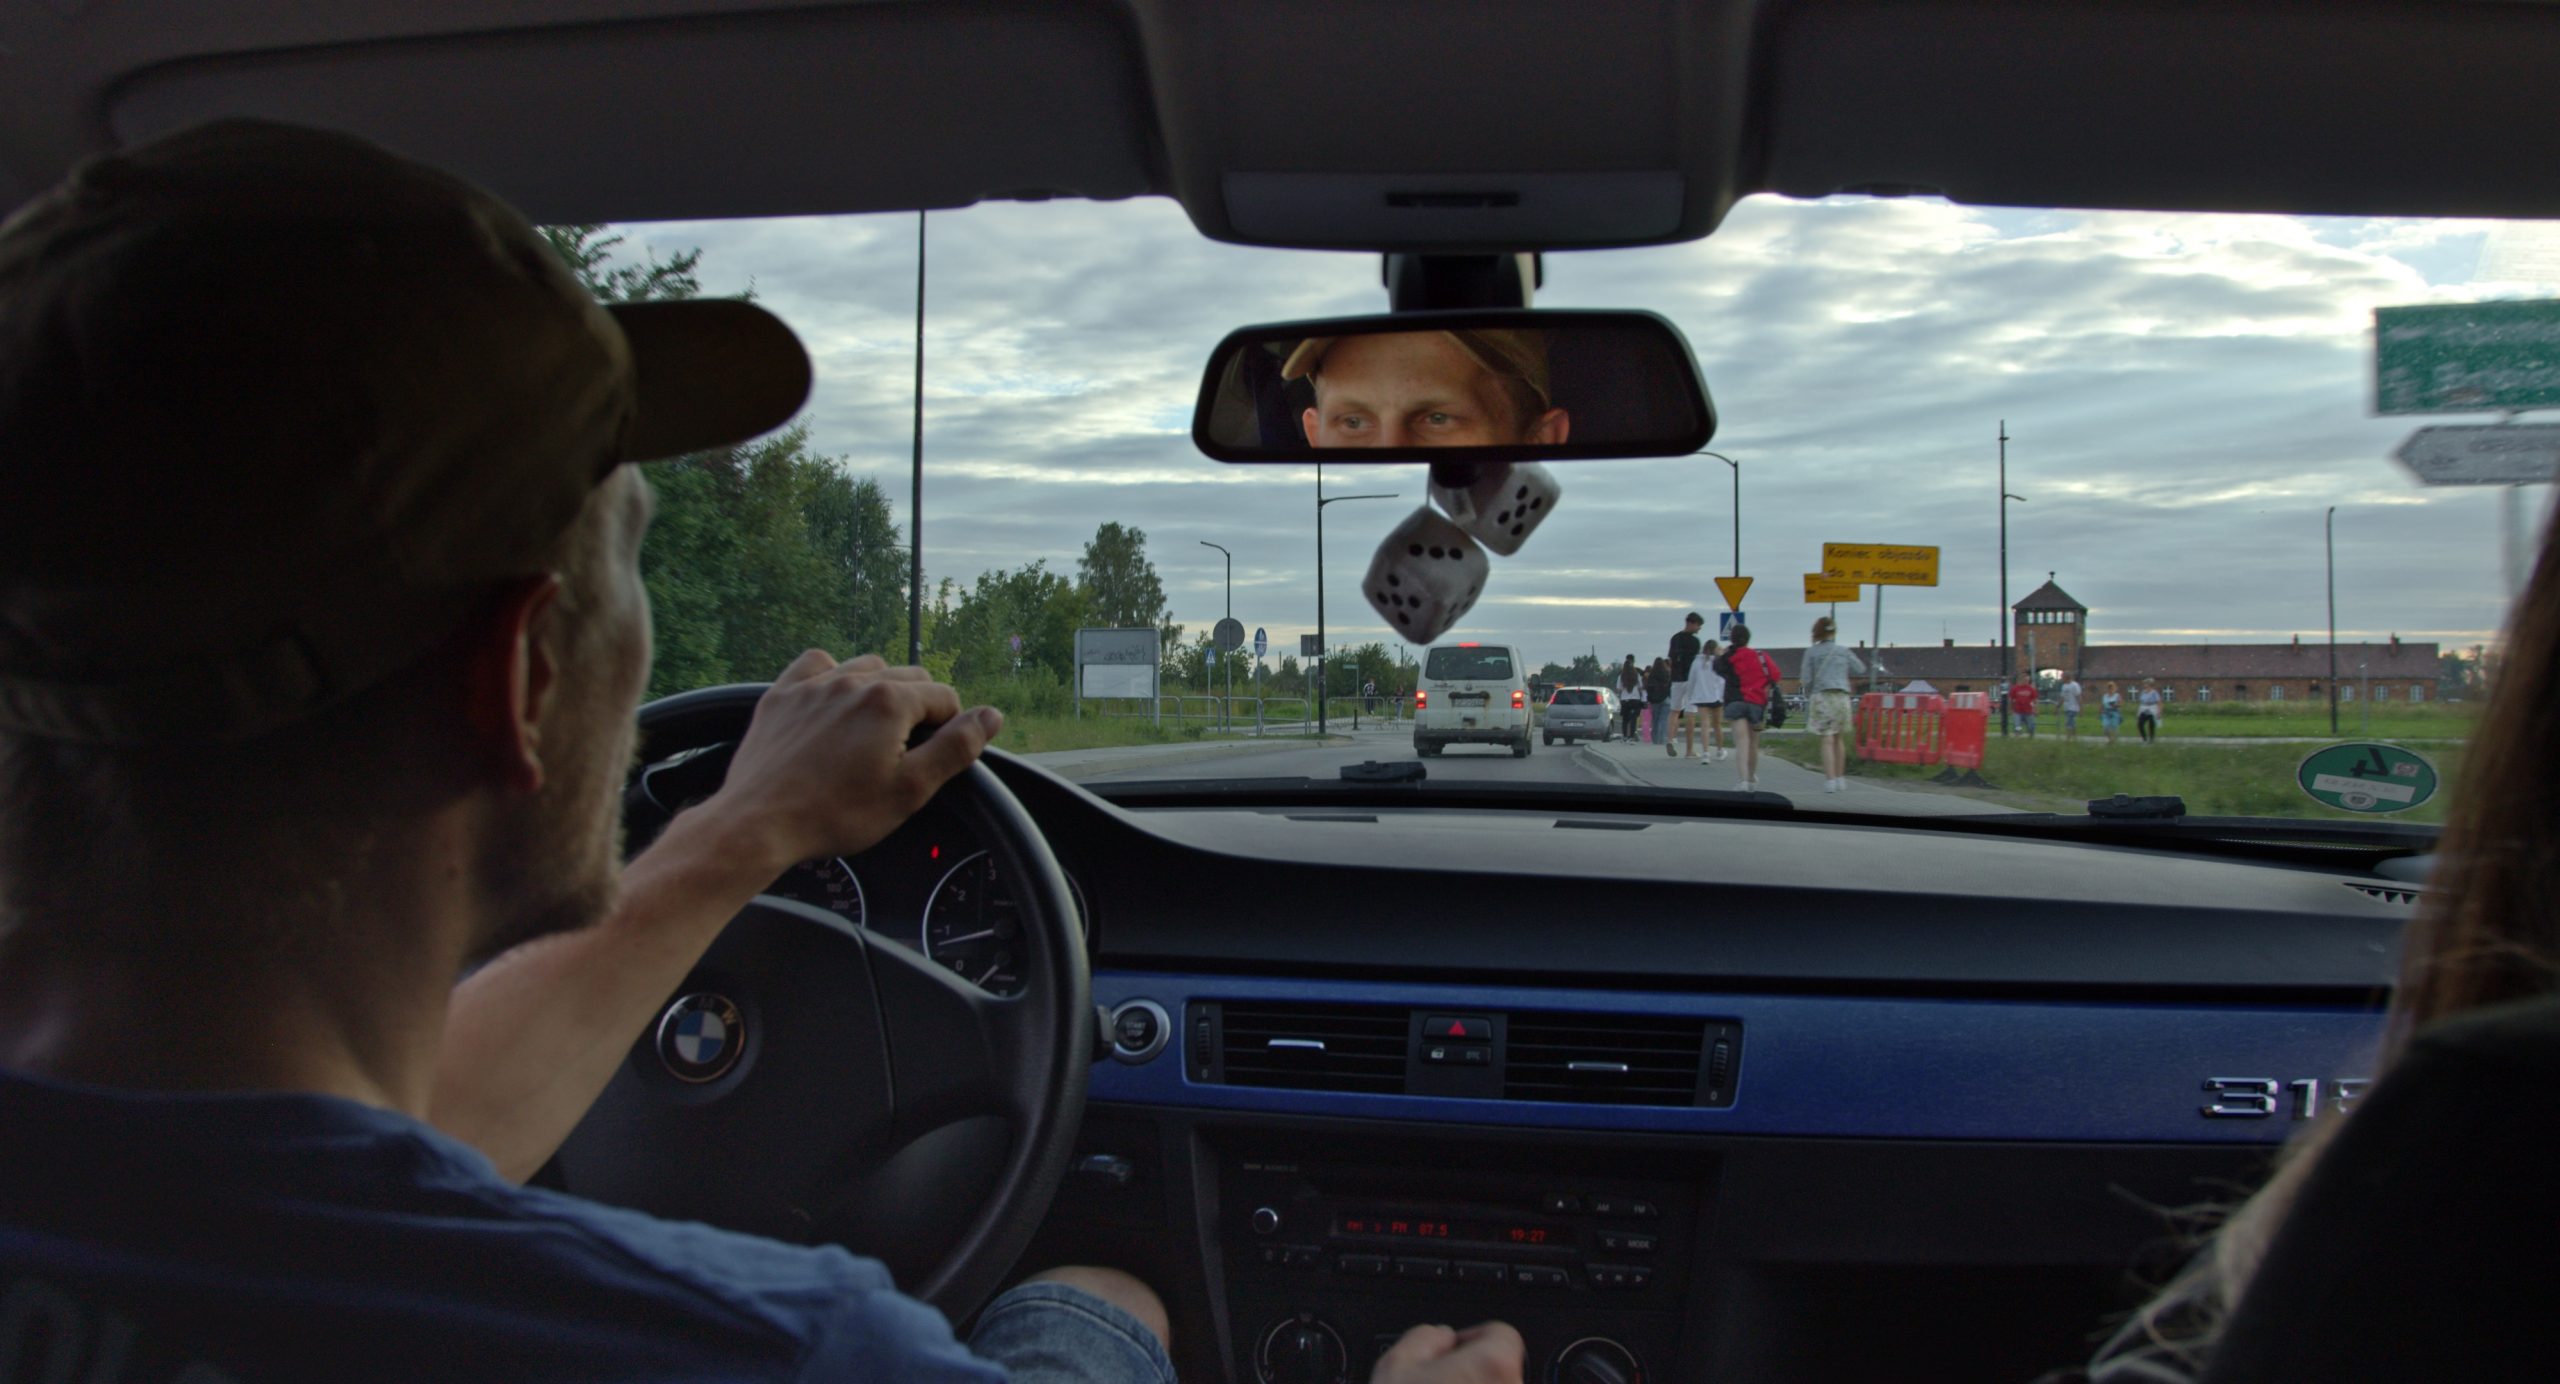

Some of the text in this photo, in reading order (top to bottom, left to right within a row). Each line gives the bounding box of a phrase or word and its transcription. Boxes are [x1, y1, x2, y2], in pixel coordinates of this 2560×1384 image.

[1826, 546, 1931, 562] Koniec objazdu
[1828, 566, 1845, 578] do
[988, 869, 997, 881] 3
[957, 890, 967, 902] 2
[832, 900, 850, 910] 200
[955, 959, 964, 971] 0
[1511, 1228, 1546, 1243] 19:27
